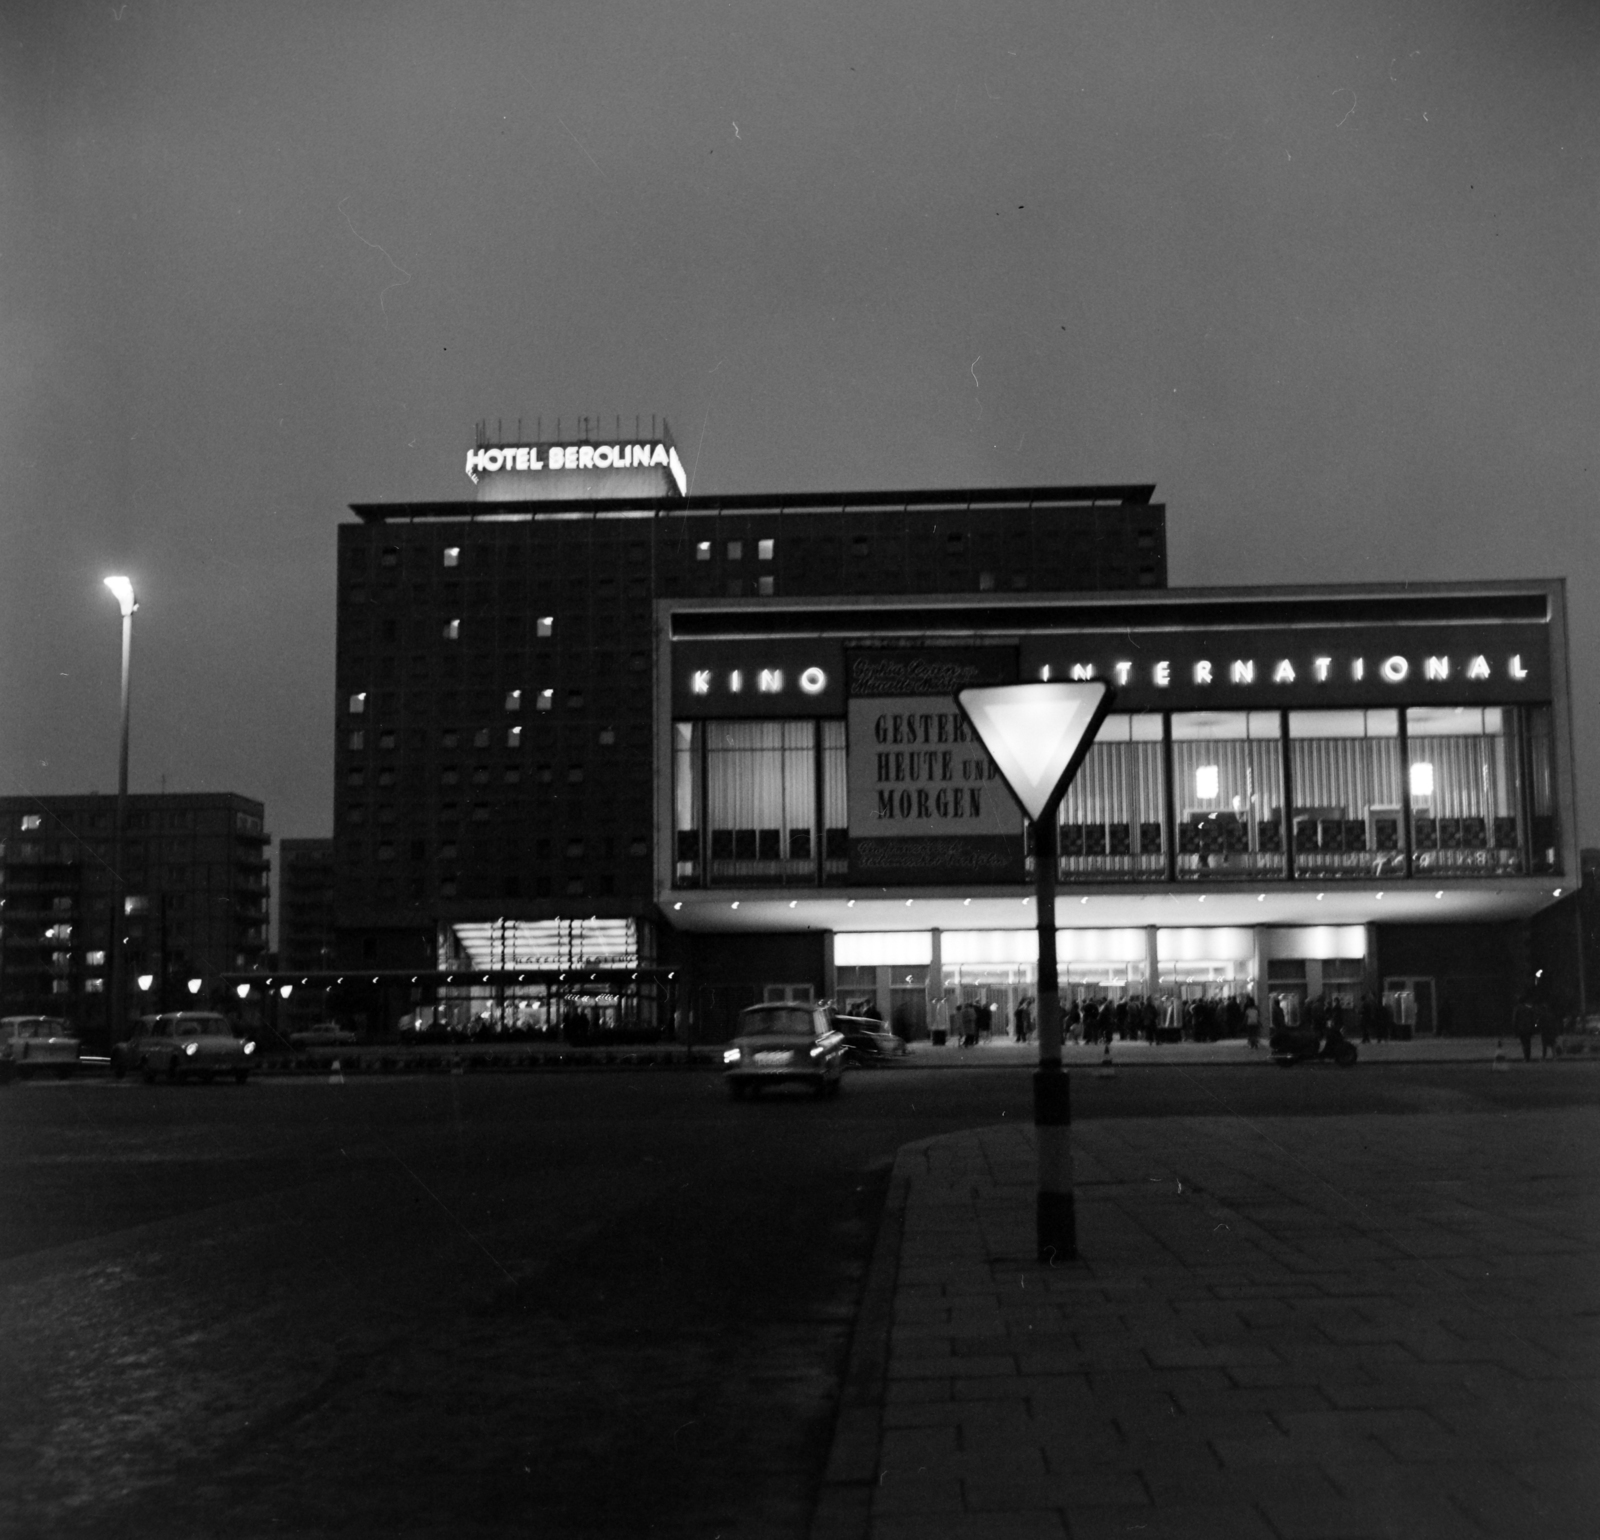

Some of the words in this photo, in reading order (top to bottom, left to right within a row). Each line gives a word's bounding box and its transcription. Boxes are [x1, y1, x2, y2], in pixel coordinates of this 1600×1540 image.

[467, 447, 543, 471] HOTEL
[549, 444, 669, 469] BEROLINA
[692, 667, 826, 694] KINO
[1040, 654, 1528, 687] INTERNATIONAL
[874, 712, 977, 745] GESTER
[876, 750, 953, 783] HEUTE
[962, 758, 997, 782] UND
[876, 787, 983, 820] MORGEN
